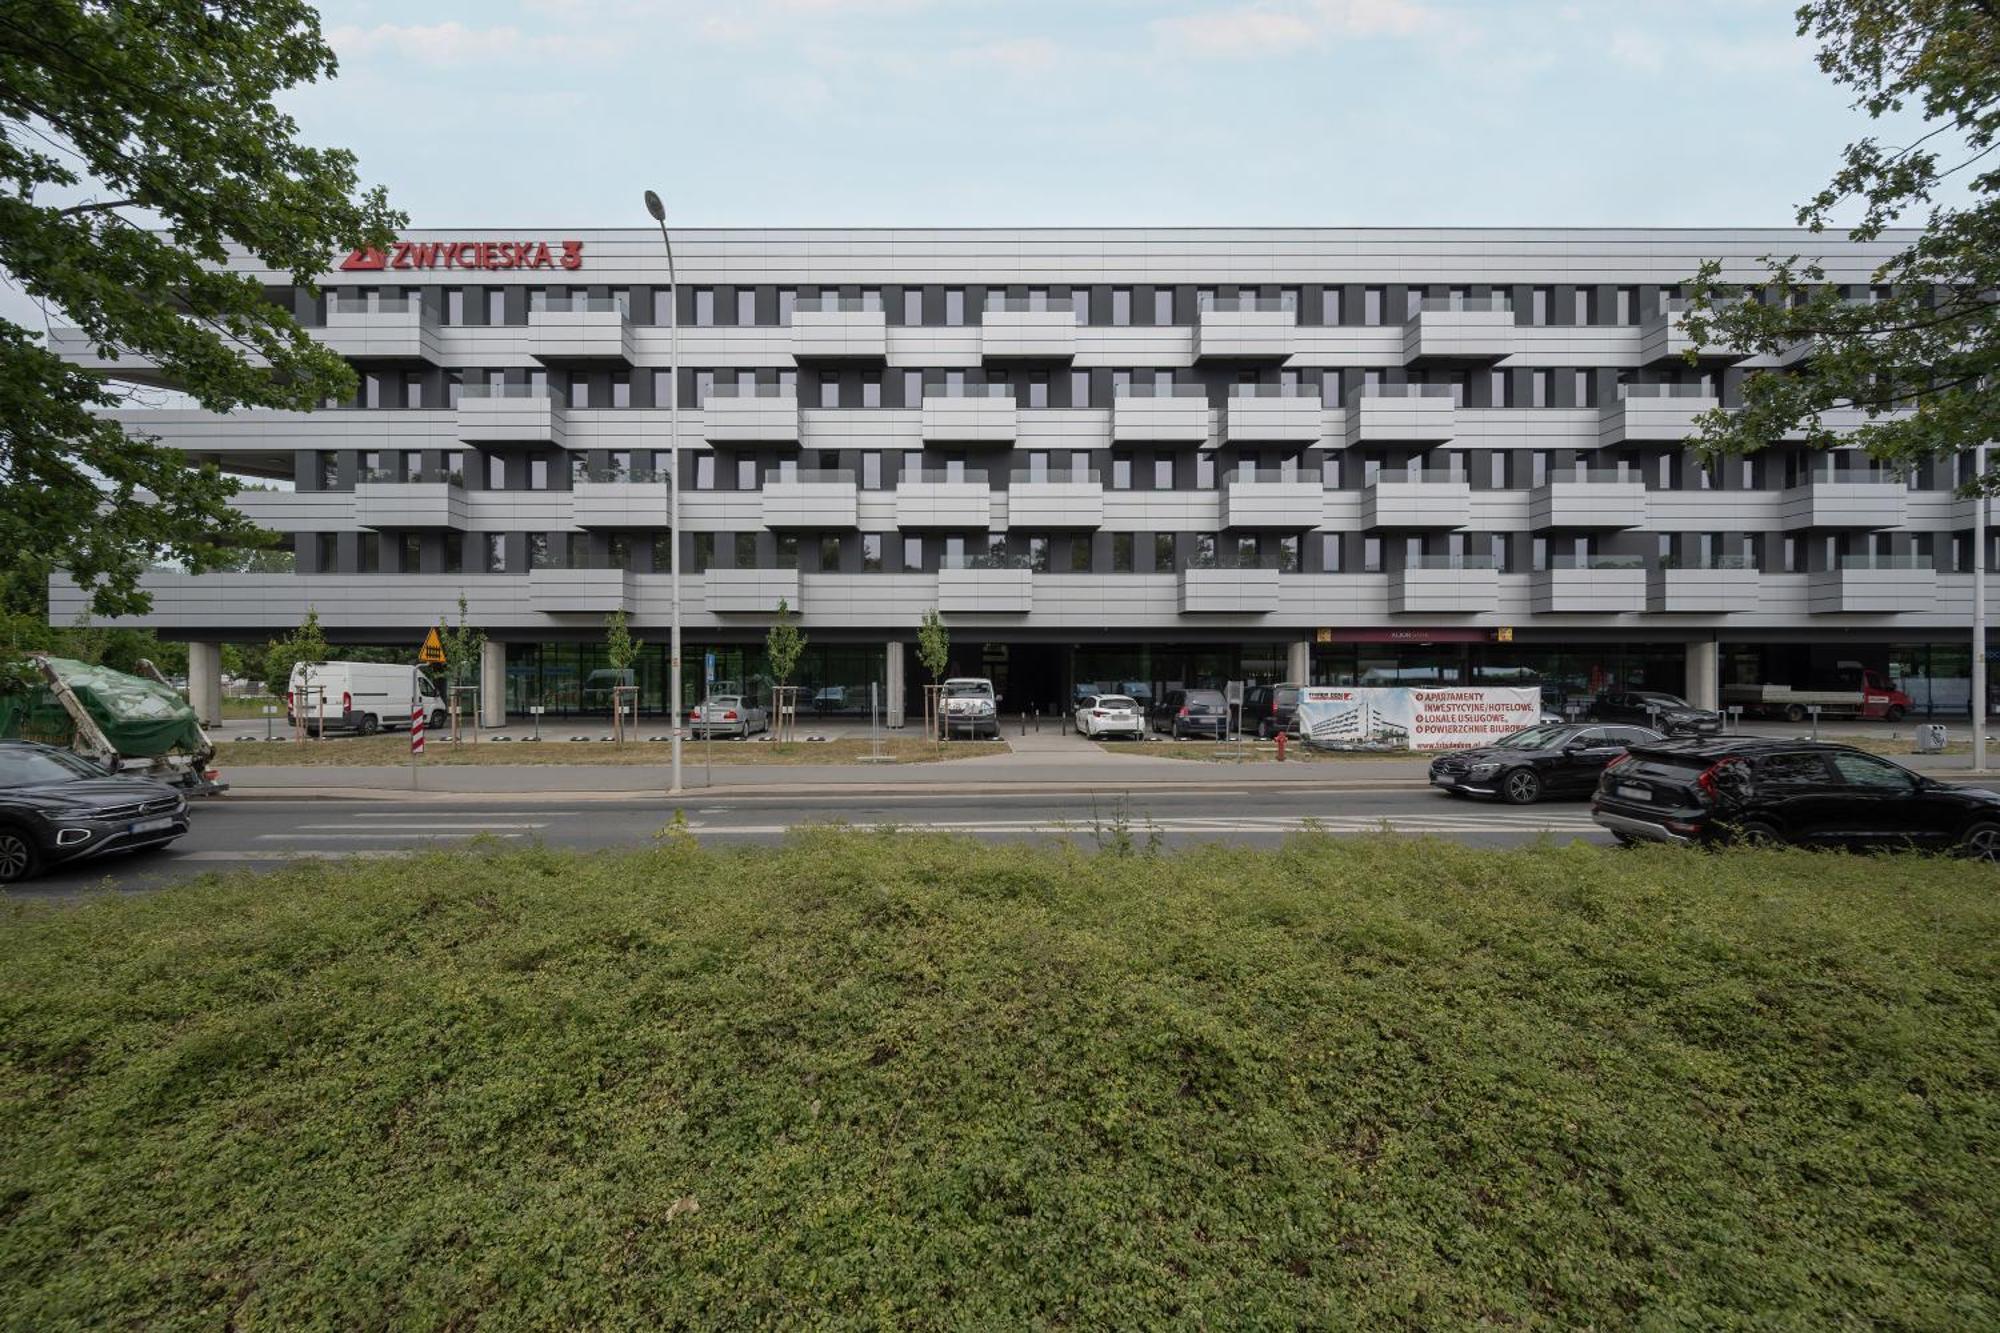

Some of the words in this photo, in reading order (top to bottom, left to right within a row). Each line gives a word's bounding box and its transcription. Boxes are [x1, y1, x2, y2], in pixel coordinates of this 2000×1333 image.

[560, 241, 583, 270] 3
[1424, 692, 1484, 701] APARTAMENTY
[1424, 714, 1456, 723] LOKALE
[1424, 724, 1488, 734] POWIERZCHNIE
